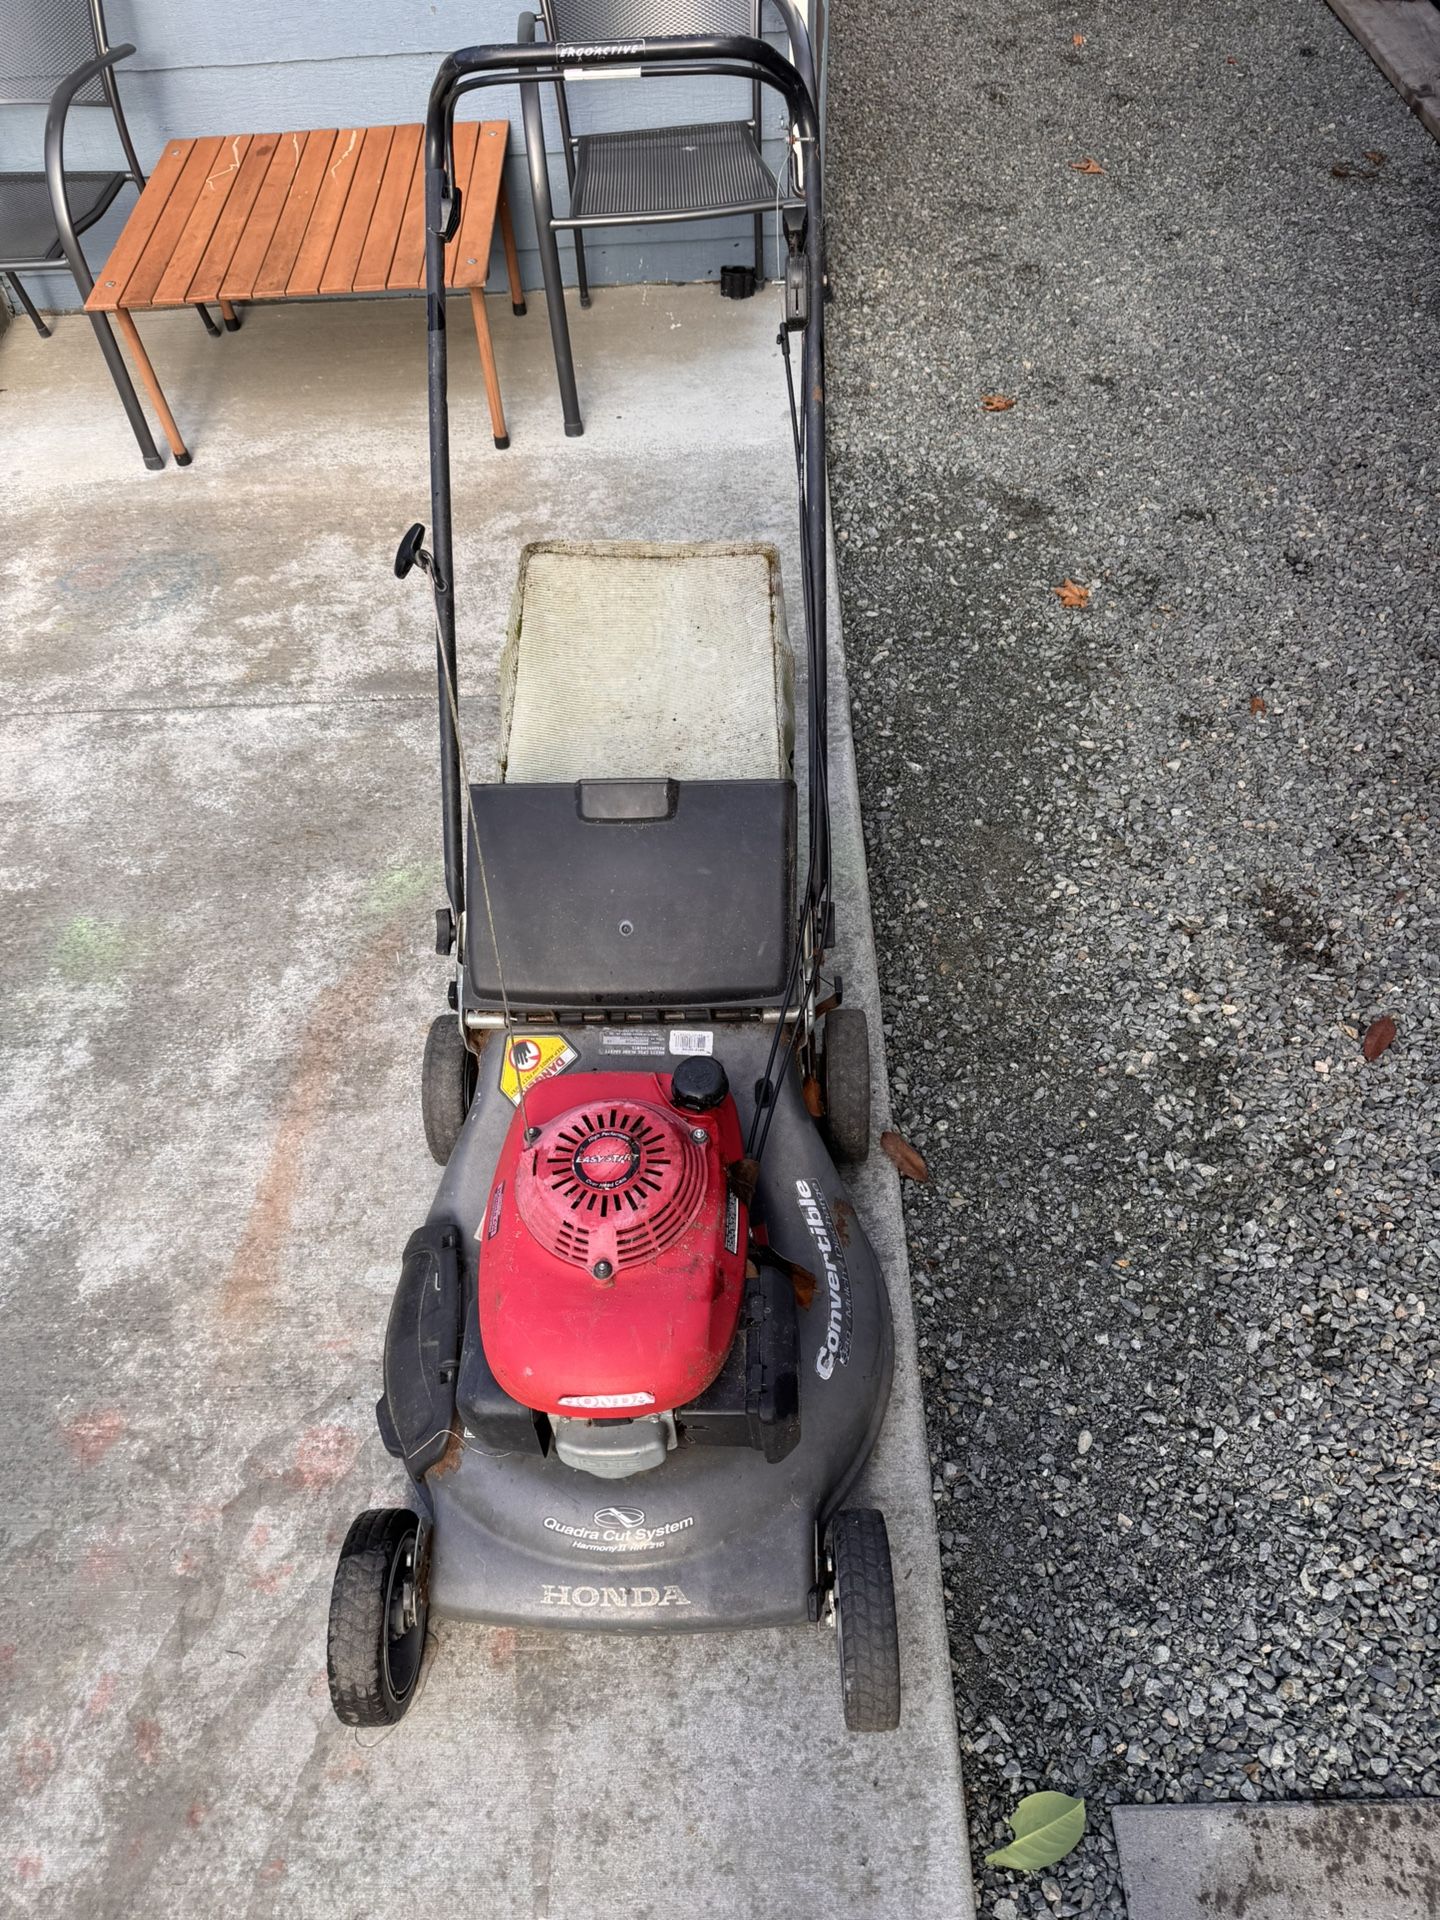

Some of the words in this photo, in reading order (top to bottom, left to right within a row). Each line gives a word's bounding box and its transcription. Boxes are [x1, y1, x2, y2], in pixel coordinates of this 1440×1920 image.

[796, 1178, 842, 1380] Convertible
[557, 1392, 655, 1408] HONDA
[543, 1516, 599, 1540] Quadra
[602, 1529, 632, 1542] Cut
[634, 1516, 694, 1542] System
[572, 1541, 618, 1553] Harmony
[540, 1584, 691, 1608] HONDA
